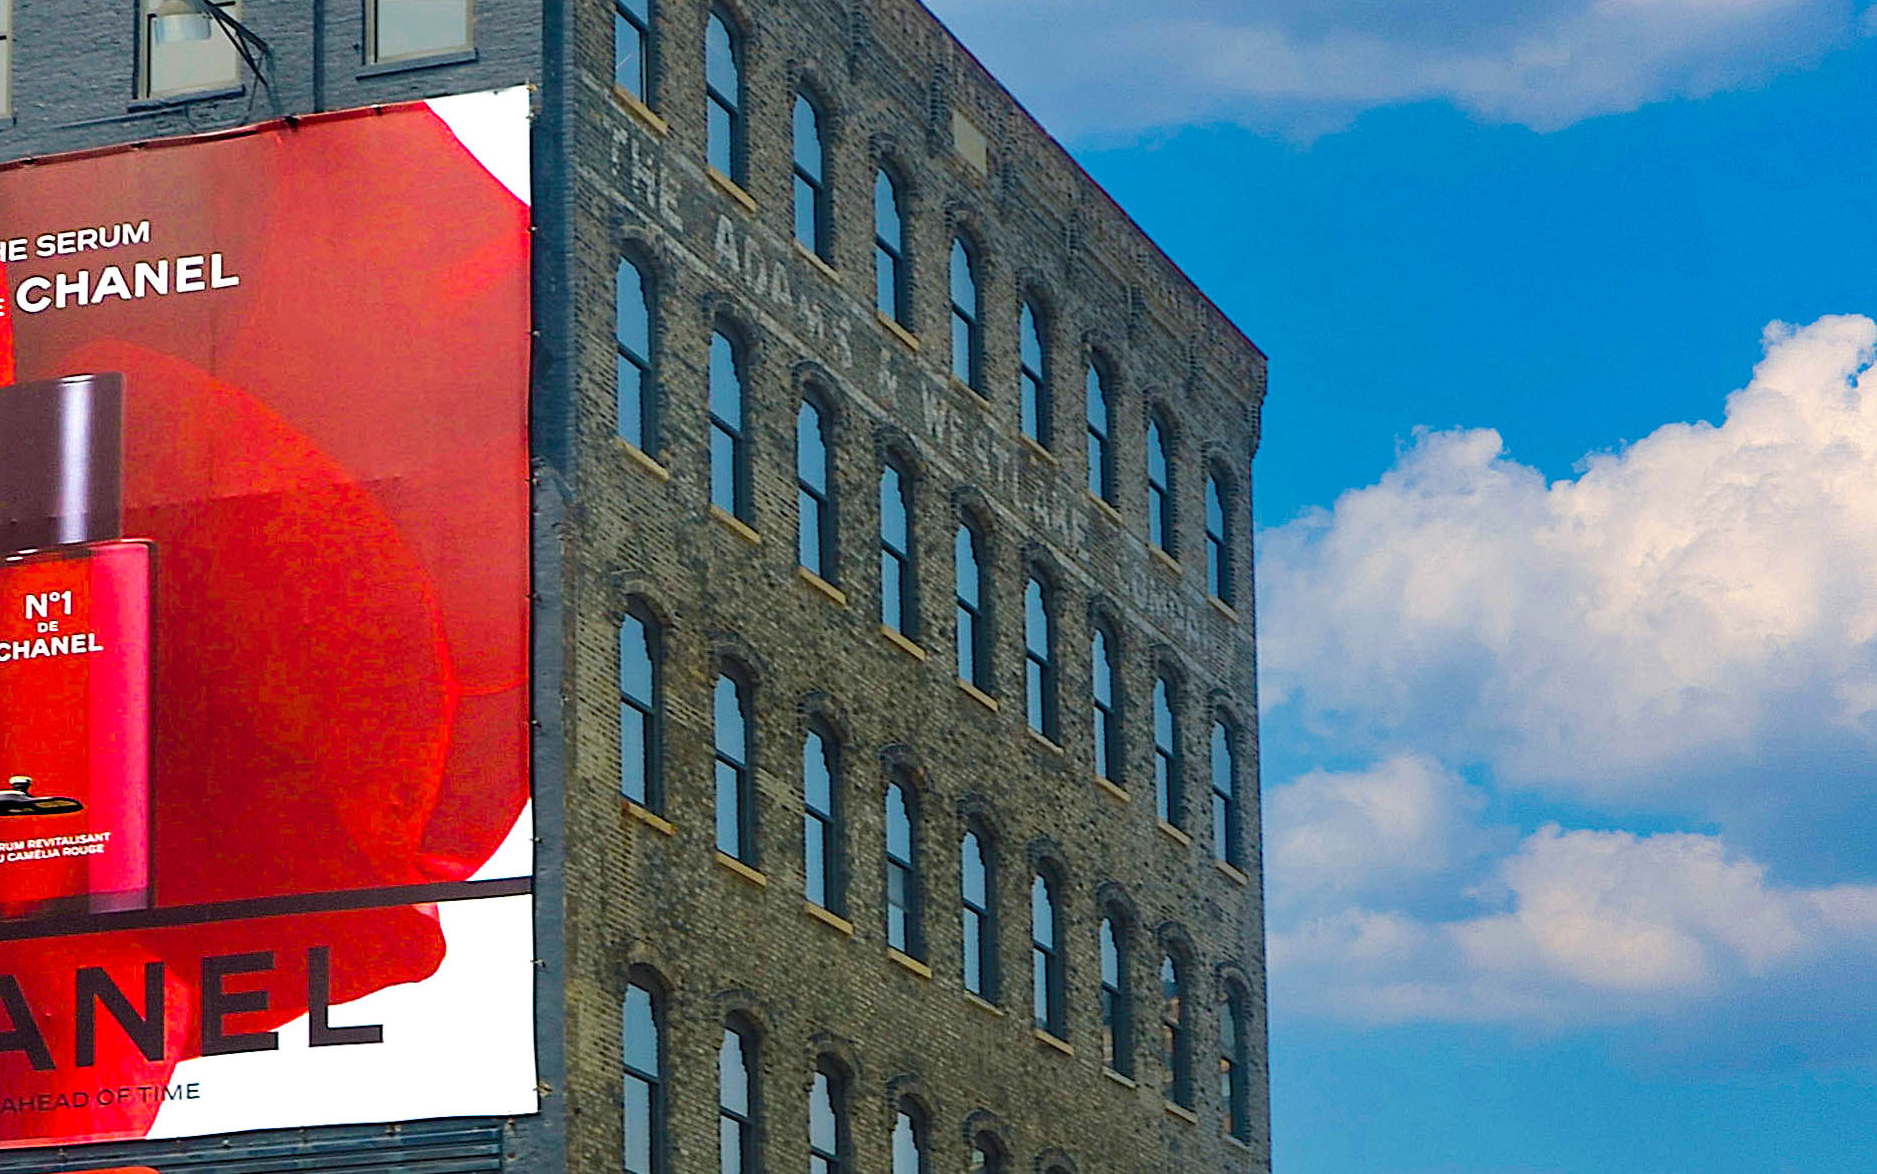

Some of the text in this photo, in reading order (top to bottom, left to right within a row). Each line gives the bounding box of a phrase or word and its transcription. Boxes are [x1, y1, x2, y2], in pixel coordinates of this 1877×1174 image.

[610, 127, 684, 233] THE
[35, 220, 150, 258] SERUM
[16, 252, 240, 314] CHANEL
[37, 620, 59, 633] DE
[27, 831, 112, 850] REVITALISANT
[62, 843, 105, 858] ROUGE
[0, 1091, 90, 1115] AHEAD
[97, 1088, 131, 1106] OF
[139, 1083, 200, 1102] TIME
